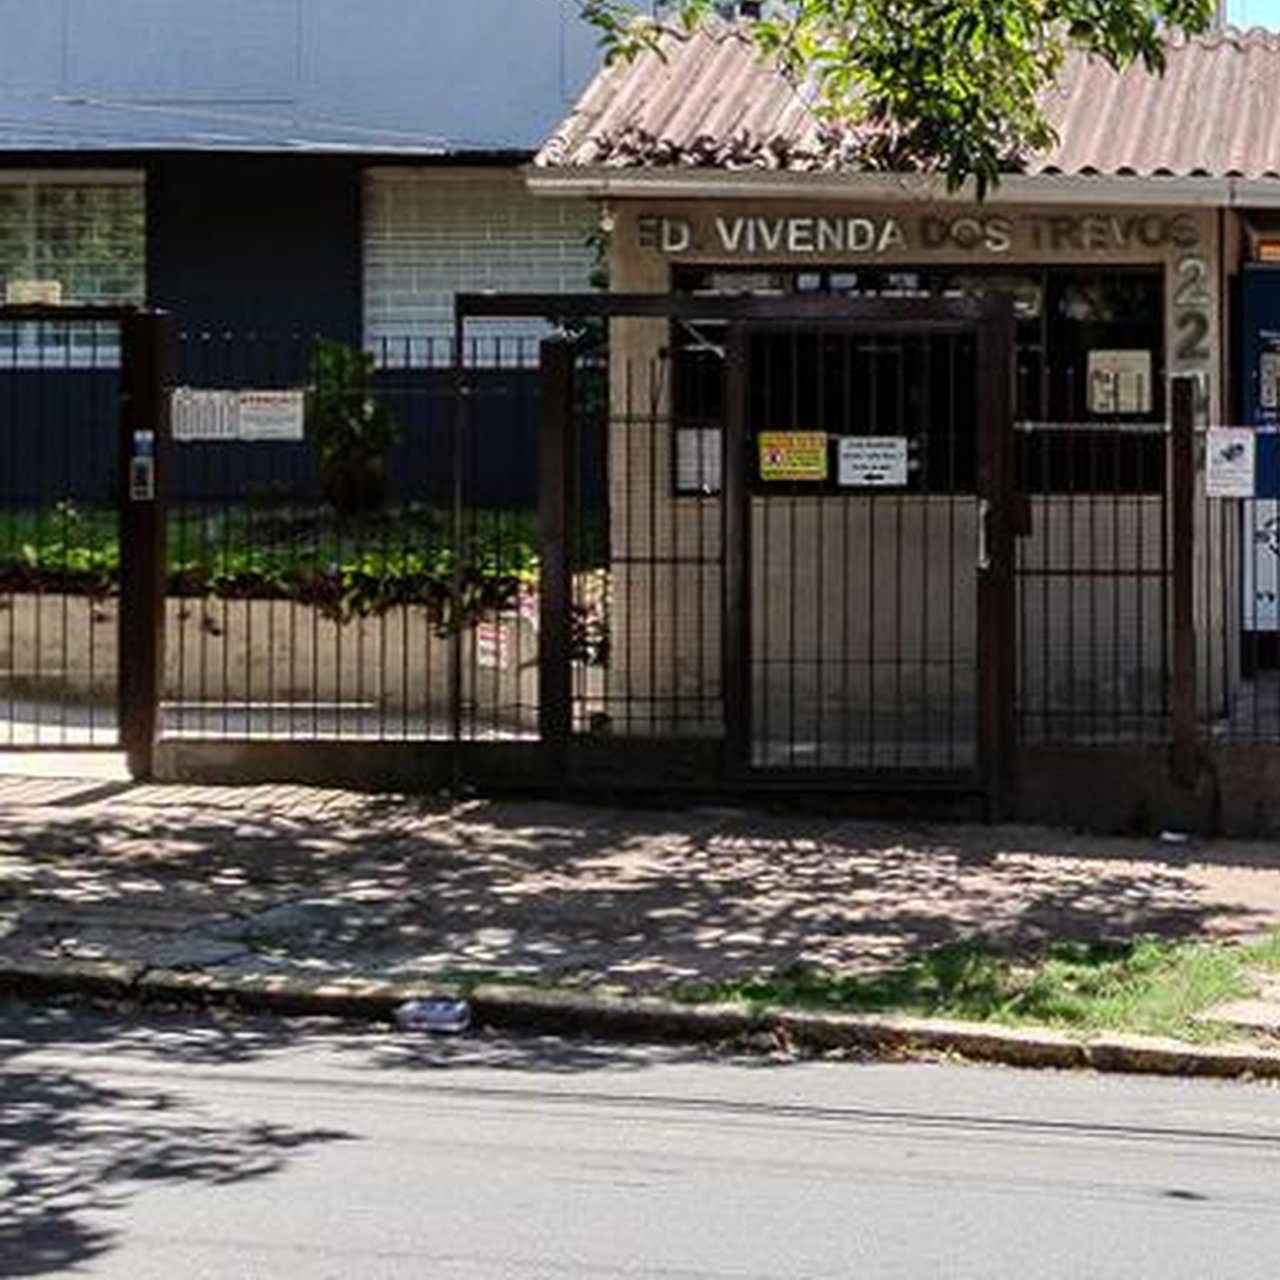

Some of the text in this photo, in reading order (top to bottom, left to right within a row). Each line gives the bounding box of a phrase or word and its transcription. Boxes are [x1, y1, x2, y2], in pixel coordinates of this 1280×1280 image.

[716, 217, 907, 251] VIVENDA
[920, 216, 1011, 252] DOS
[1022, 214, 1200, 251] TREVOS
